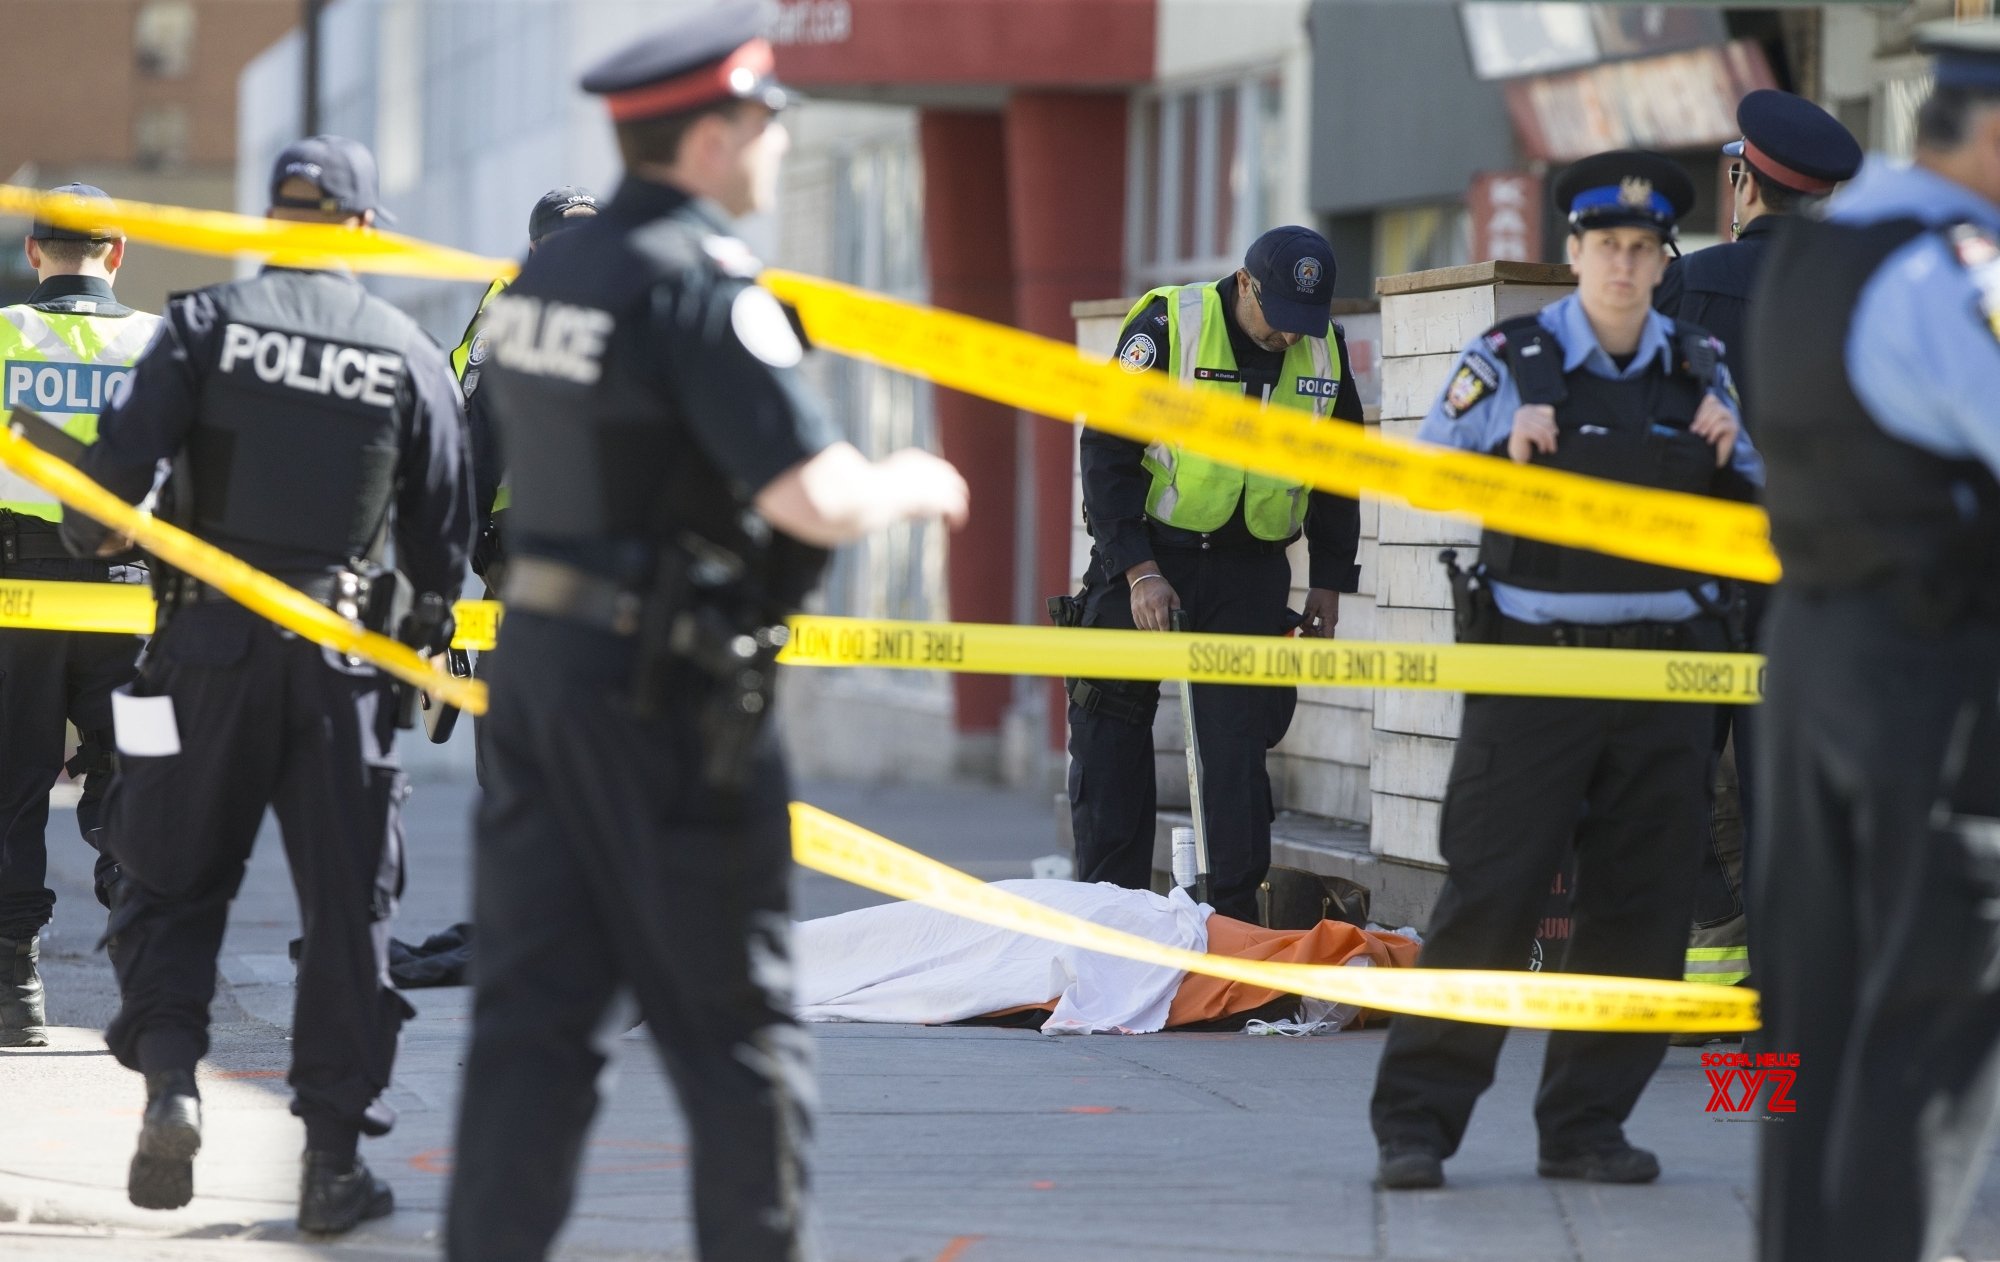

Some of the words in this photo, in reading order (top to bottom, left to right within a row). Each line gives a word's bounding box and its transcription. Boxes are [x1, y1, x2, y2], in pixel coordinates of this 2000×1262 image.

[567, 195, 596, 204] POLICE
[1134, 336, 1155, 354] TORONTO
[219, 323, 403, 408] POLICE
[9, 366, 129, 408] POLIC
[0, 588, 35, 619] FIR
[793, 626, 831, 658] NOT
[839, 627, 865, 660] DO
[871, 627, 914, 661] LINE
[922, 629, 965, 664] FIRE
[1188, 641, 1256, 676] CROSS
[1264, 646, 1303, 678] NOT
[1310, 648, 1337, 680] DO
[1343, 648, 1386, 681] LINE
[1394, 650, 1438, 684] FIRE
[1665, 660, 1735, 695] CROSS
